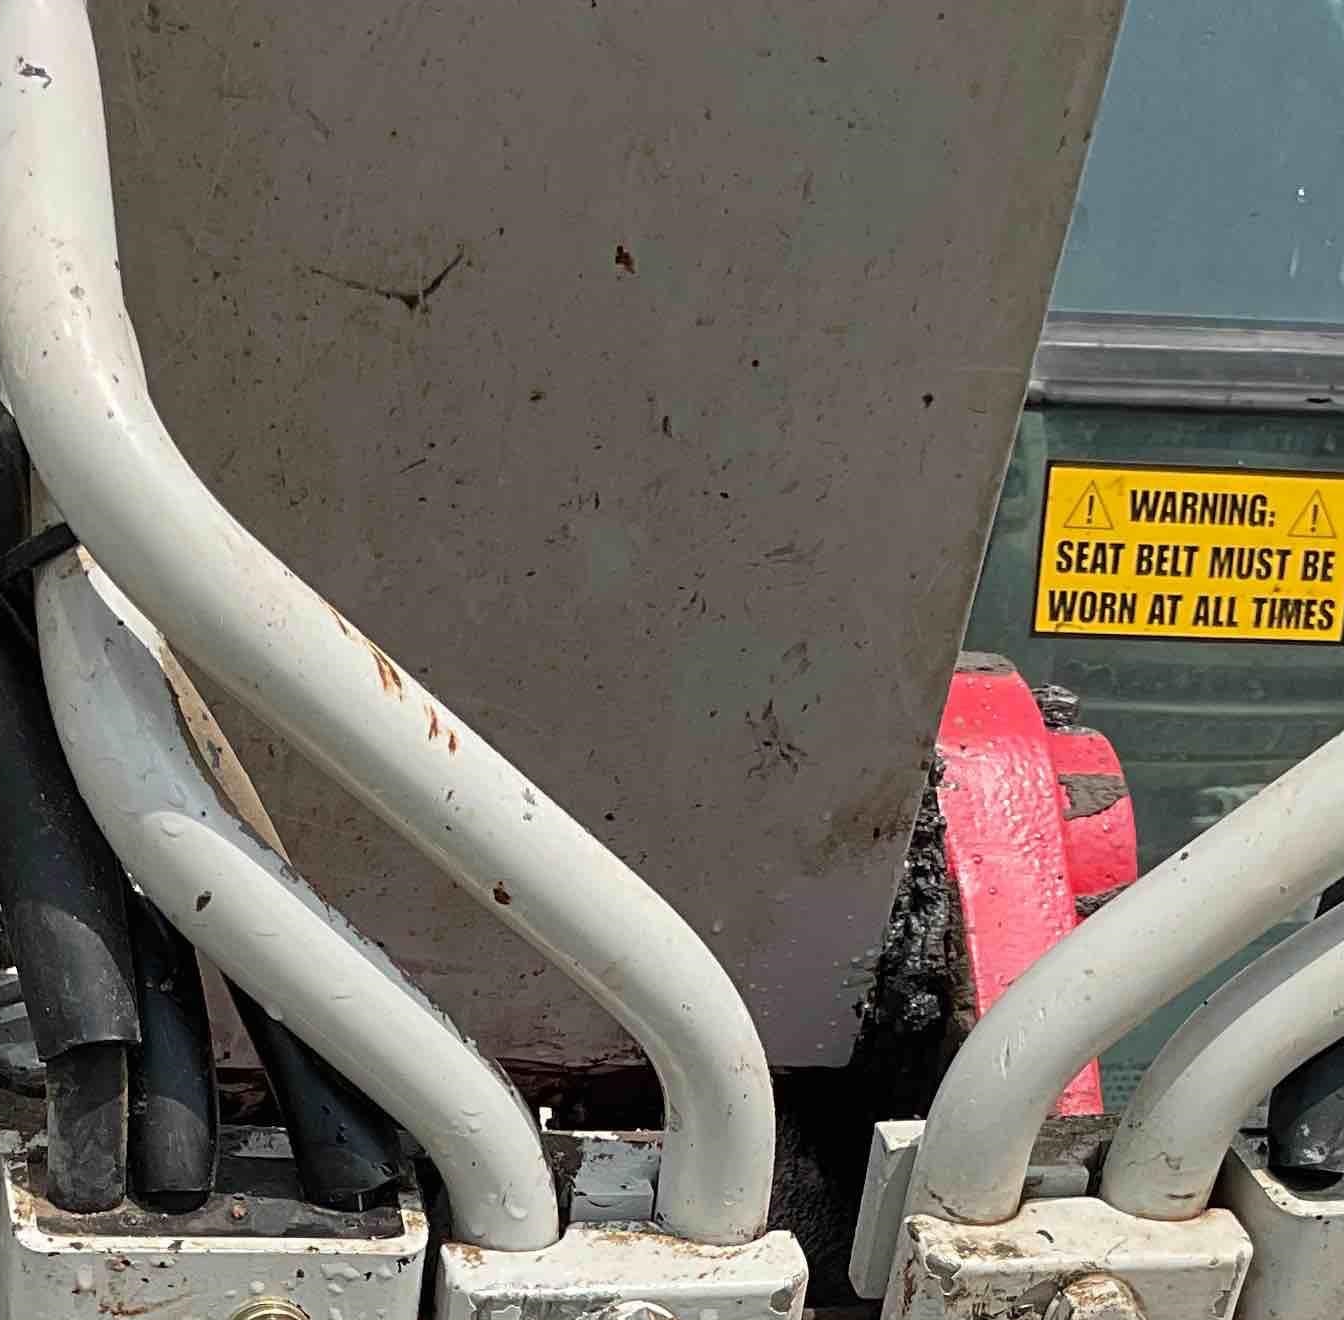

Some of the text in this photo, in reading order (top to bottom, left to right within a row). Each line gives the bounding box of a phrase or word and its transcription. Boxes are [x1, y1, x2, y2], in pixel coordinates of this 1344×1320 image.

[1131, 489, 1275, 528] WARNING:
[1056, 540, 1336, 582] SEAT BELT MUST BE
[1048, 589, 1336, 632] WORN AT ALL TIMES
